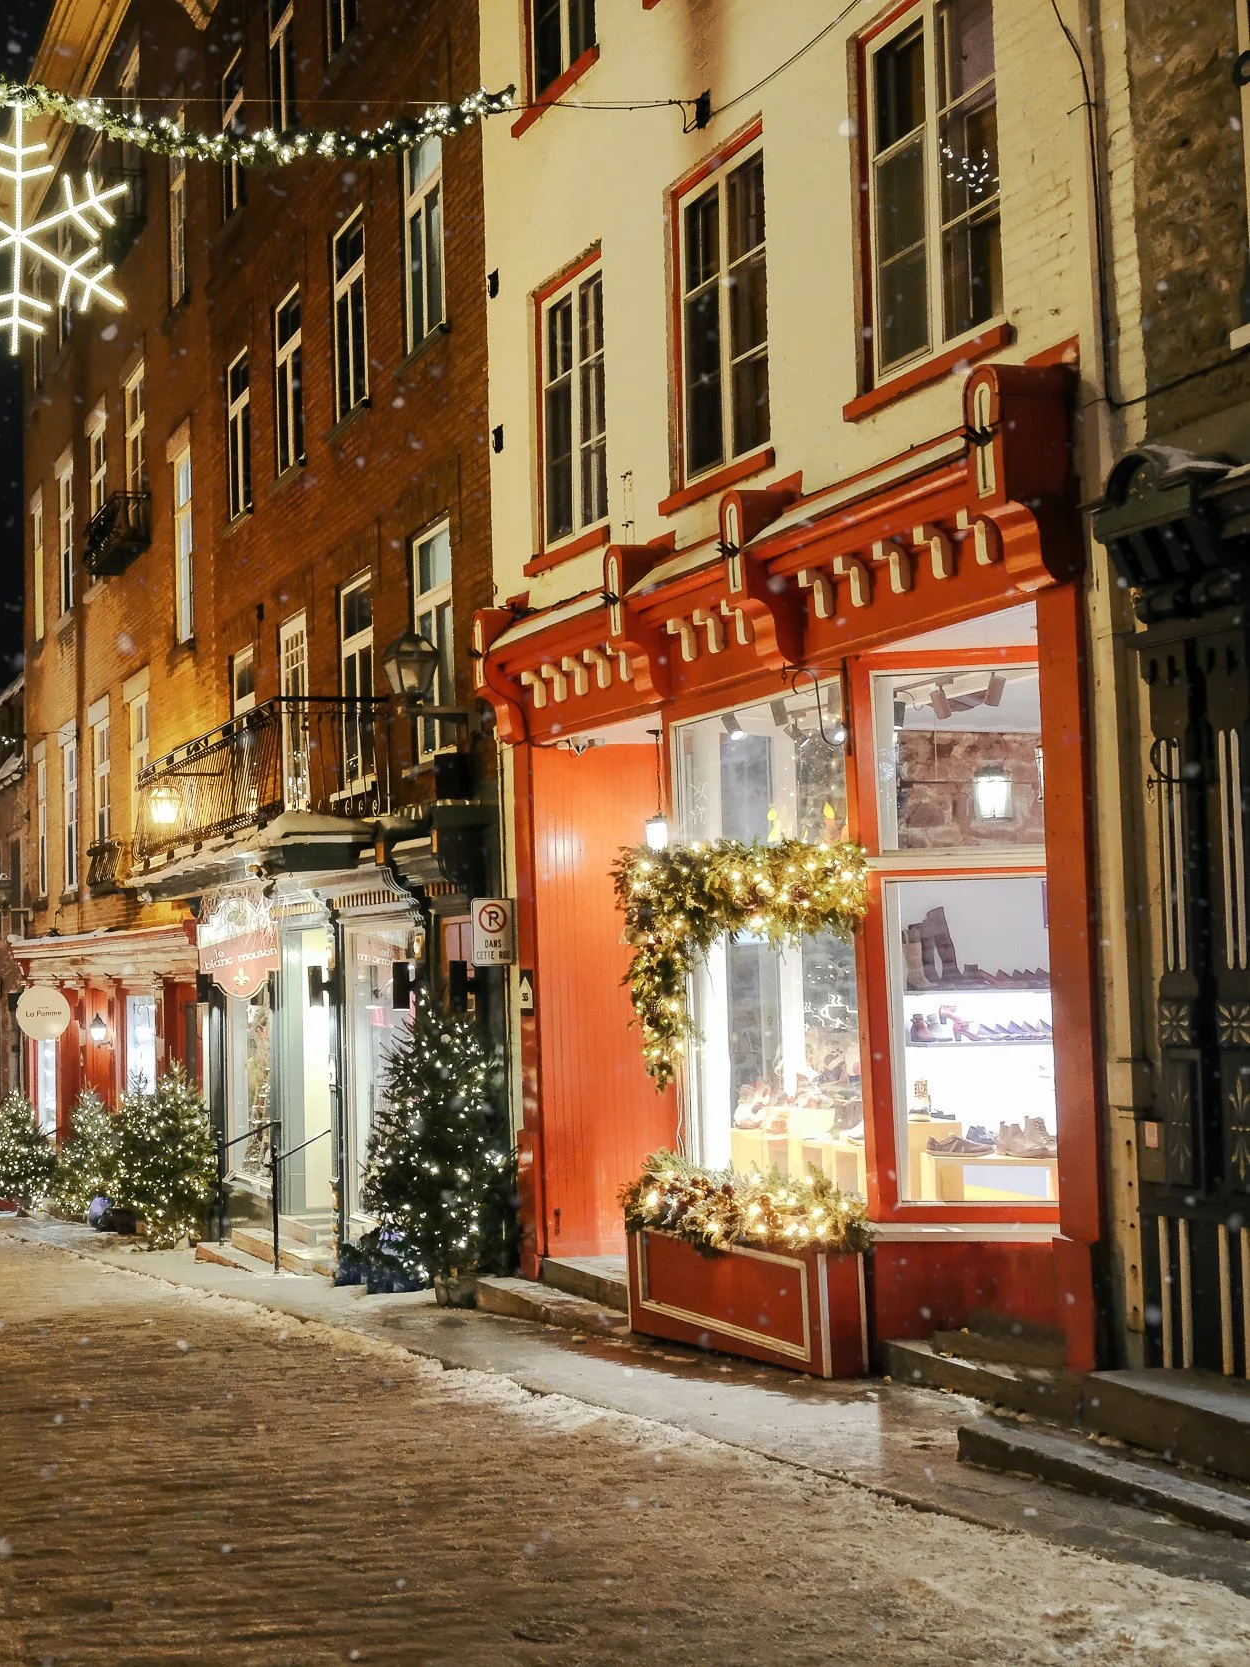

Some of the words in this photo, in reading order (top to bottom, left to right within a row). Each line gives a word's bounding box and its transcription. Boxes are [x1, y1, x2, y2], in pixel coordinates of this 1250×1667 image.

[484, 939, 502, 949] DANS
[204, 957, 234, 970] blanc
[237, 947, 278, 962] mouton
[214, 949, 225, 958] le
[476, 950, 495, 960] CETTE
[499, 950, 511, 960] RUE
